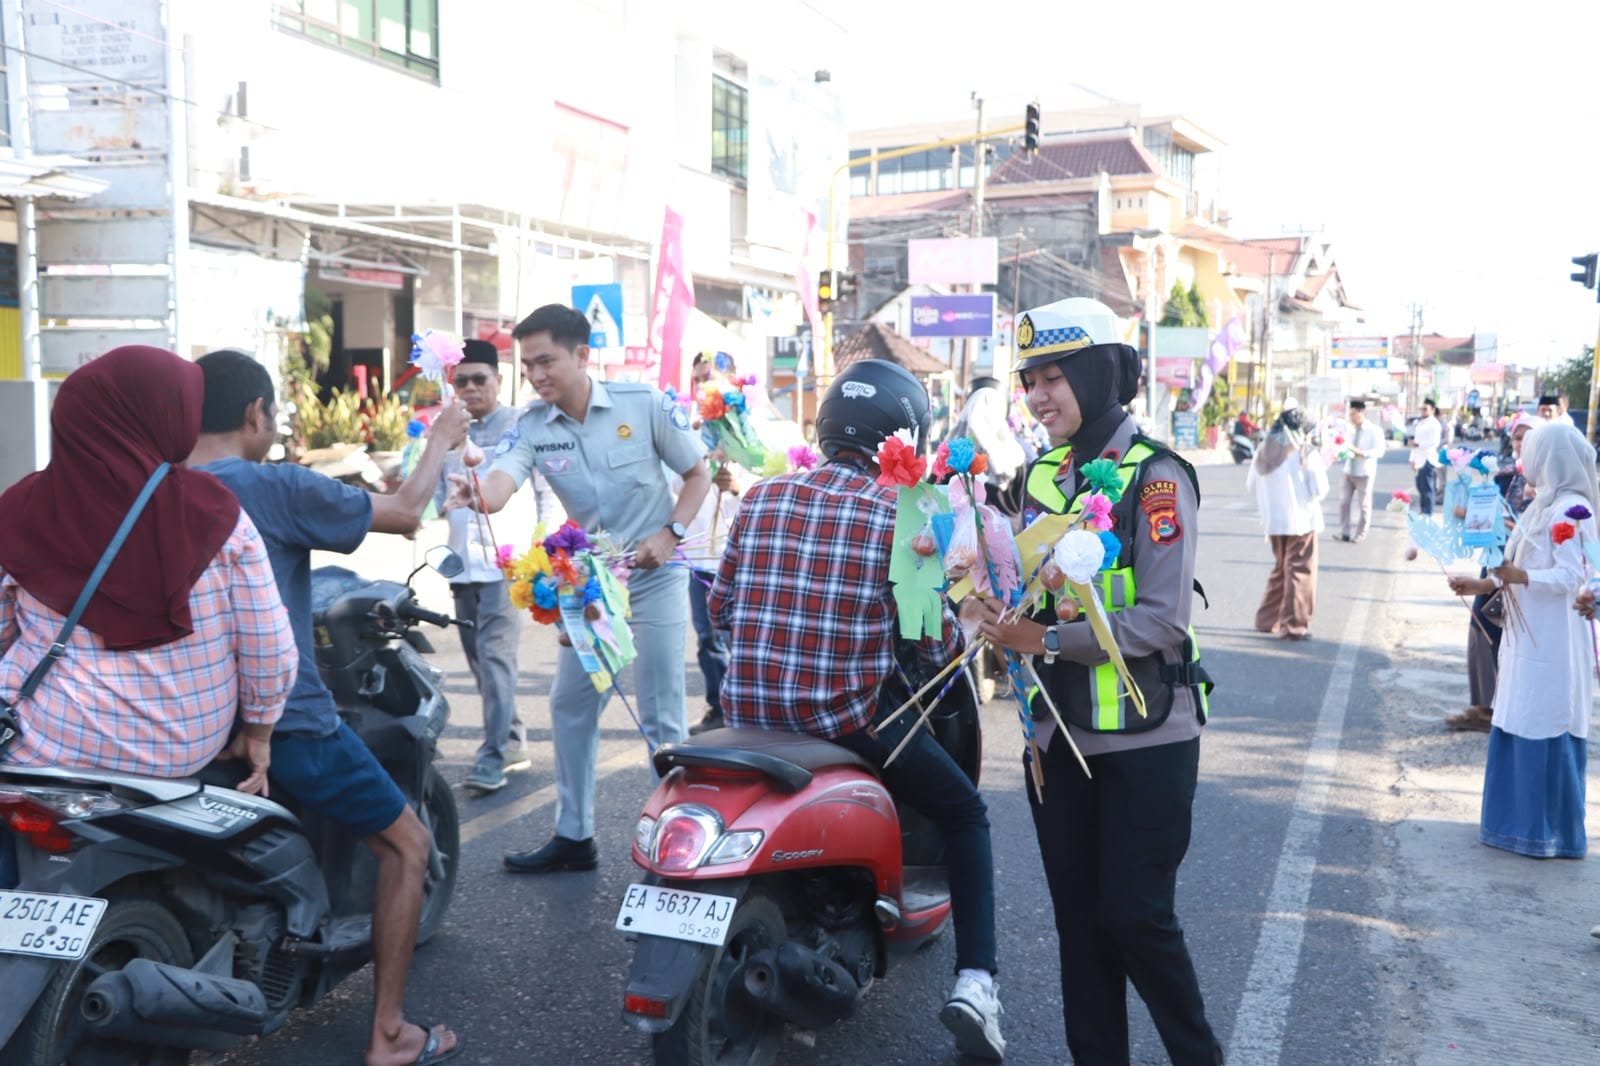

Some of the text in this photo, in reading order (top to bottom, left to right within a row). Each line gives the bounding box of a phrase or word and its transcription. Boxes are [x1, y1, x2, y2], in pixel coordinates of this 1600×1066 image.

[534, 442, 574, 453] WISNU
[3, 897, 94, 926] 2501 AE
[625, 887, 731, 922] EA 5637 AJ
